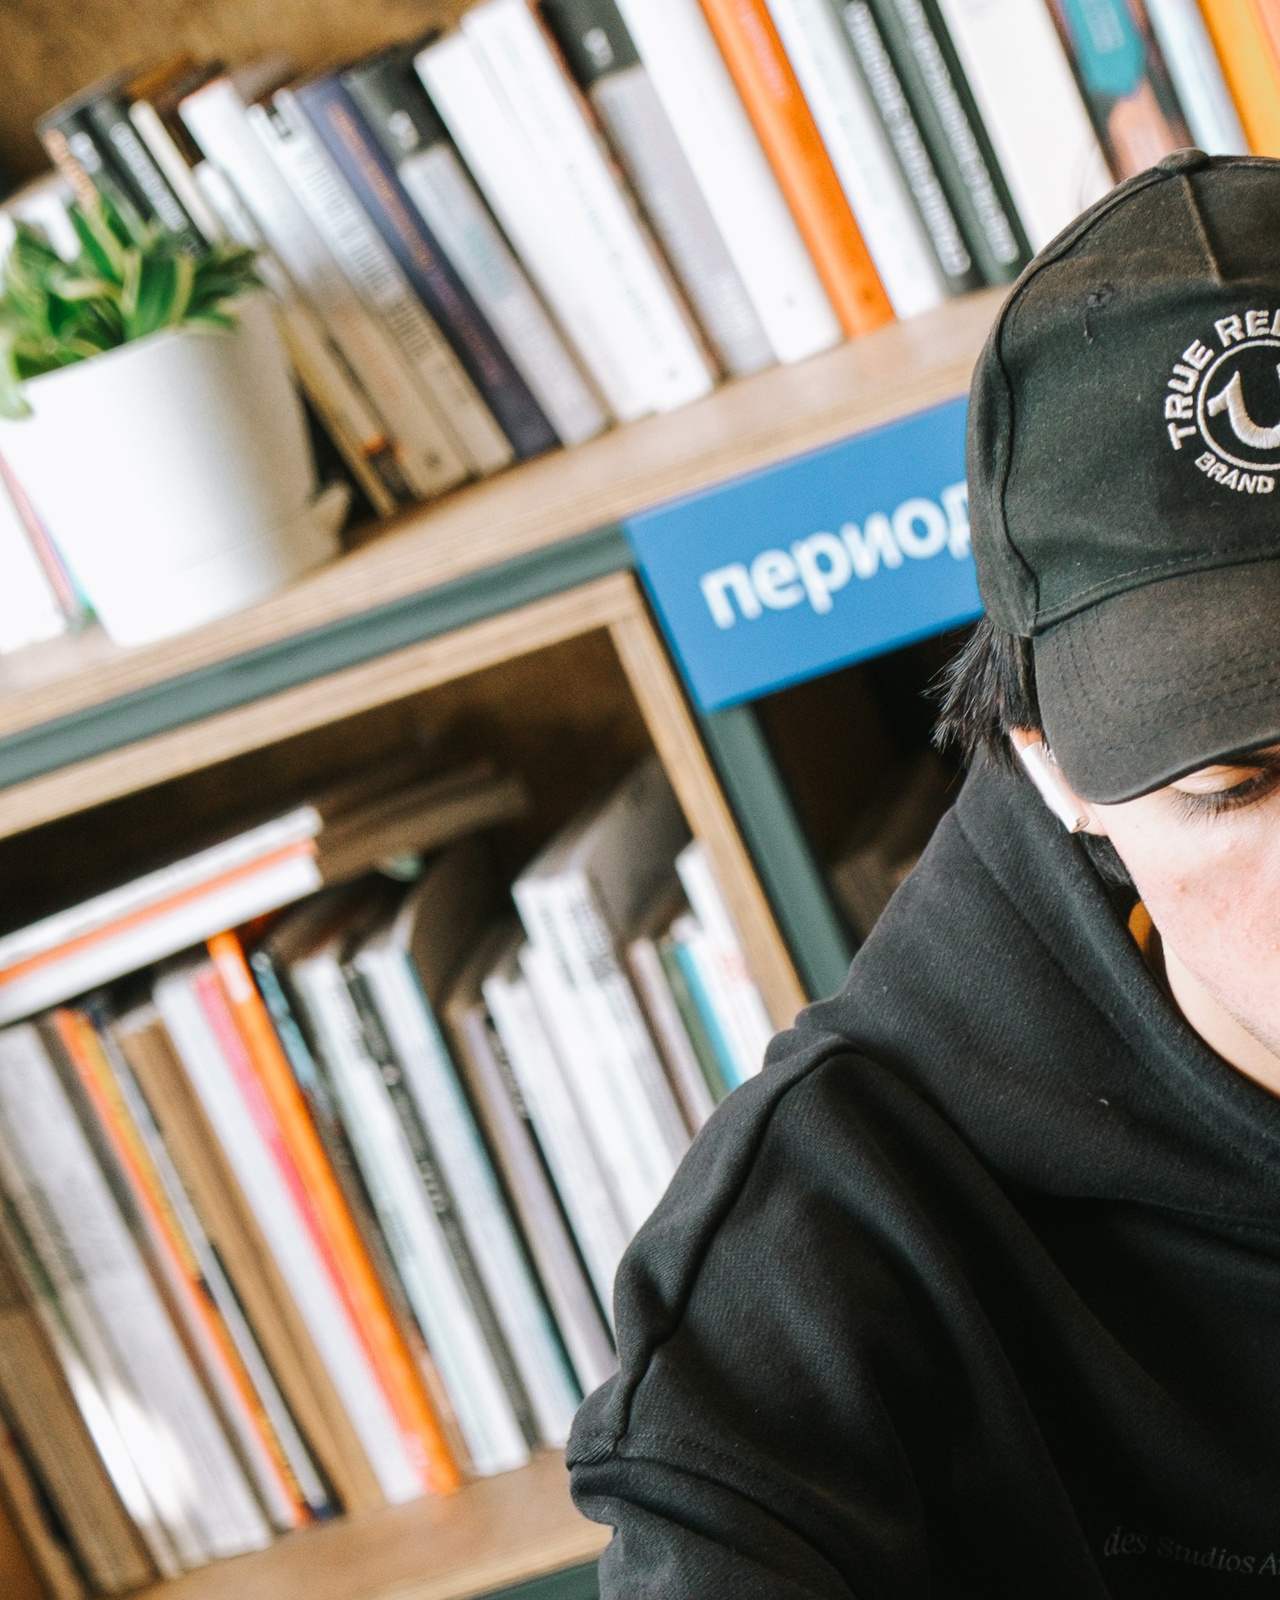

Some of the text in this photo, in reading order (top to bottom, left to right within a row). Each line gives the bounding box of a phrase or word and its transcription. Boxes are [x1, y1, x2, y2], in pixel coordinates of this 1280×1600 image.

[1164, 338, 1215, 450] TRUE
[1194, 451, 1275, 494] BRAND
[1104, 1525, 1148, 1557] des
[1156, 1535, 1255, 1575] Studios
